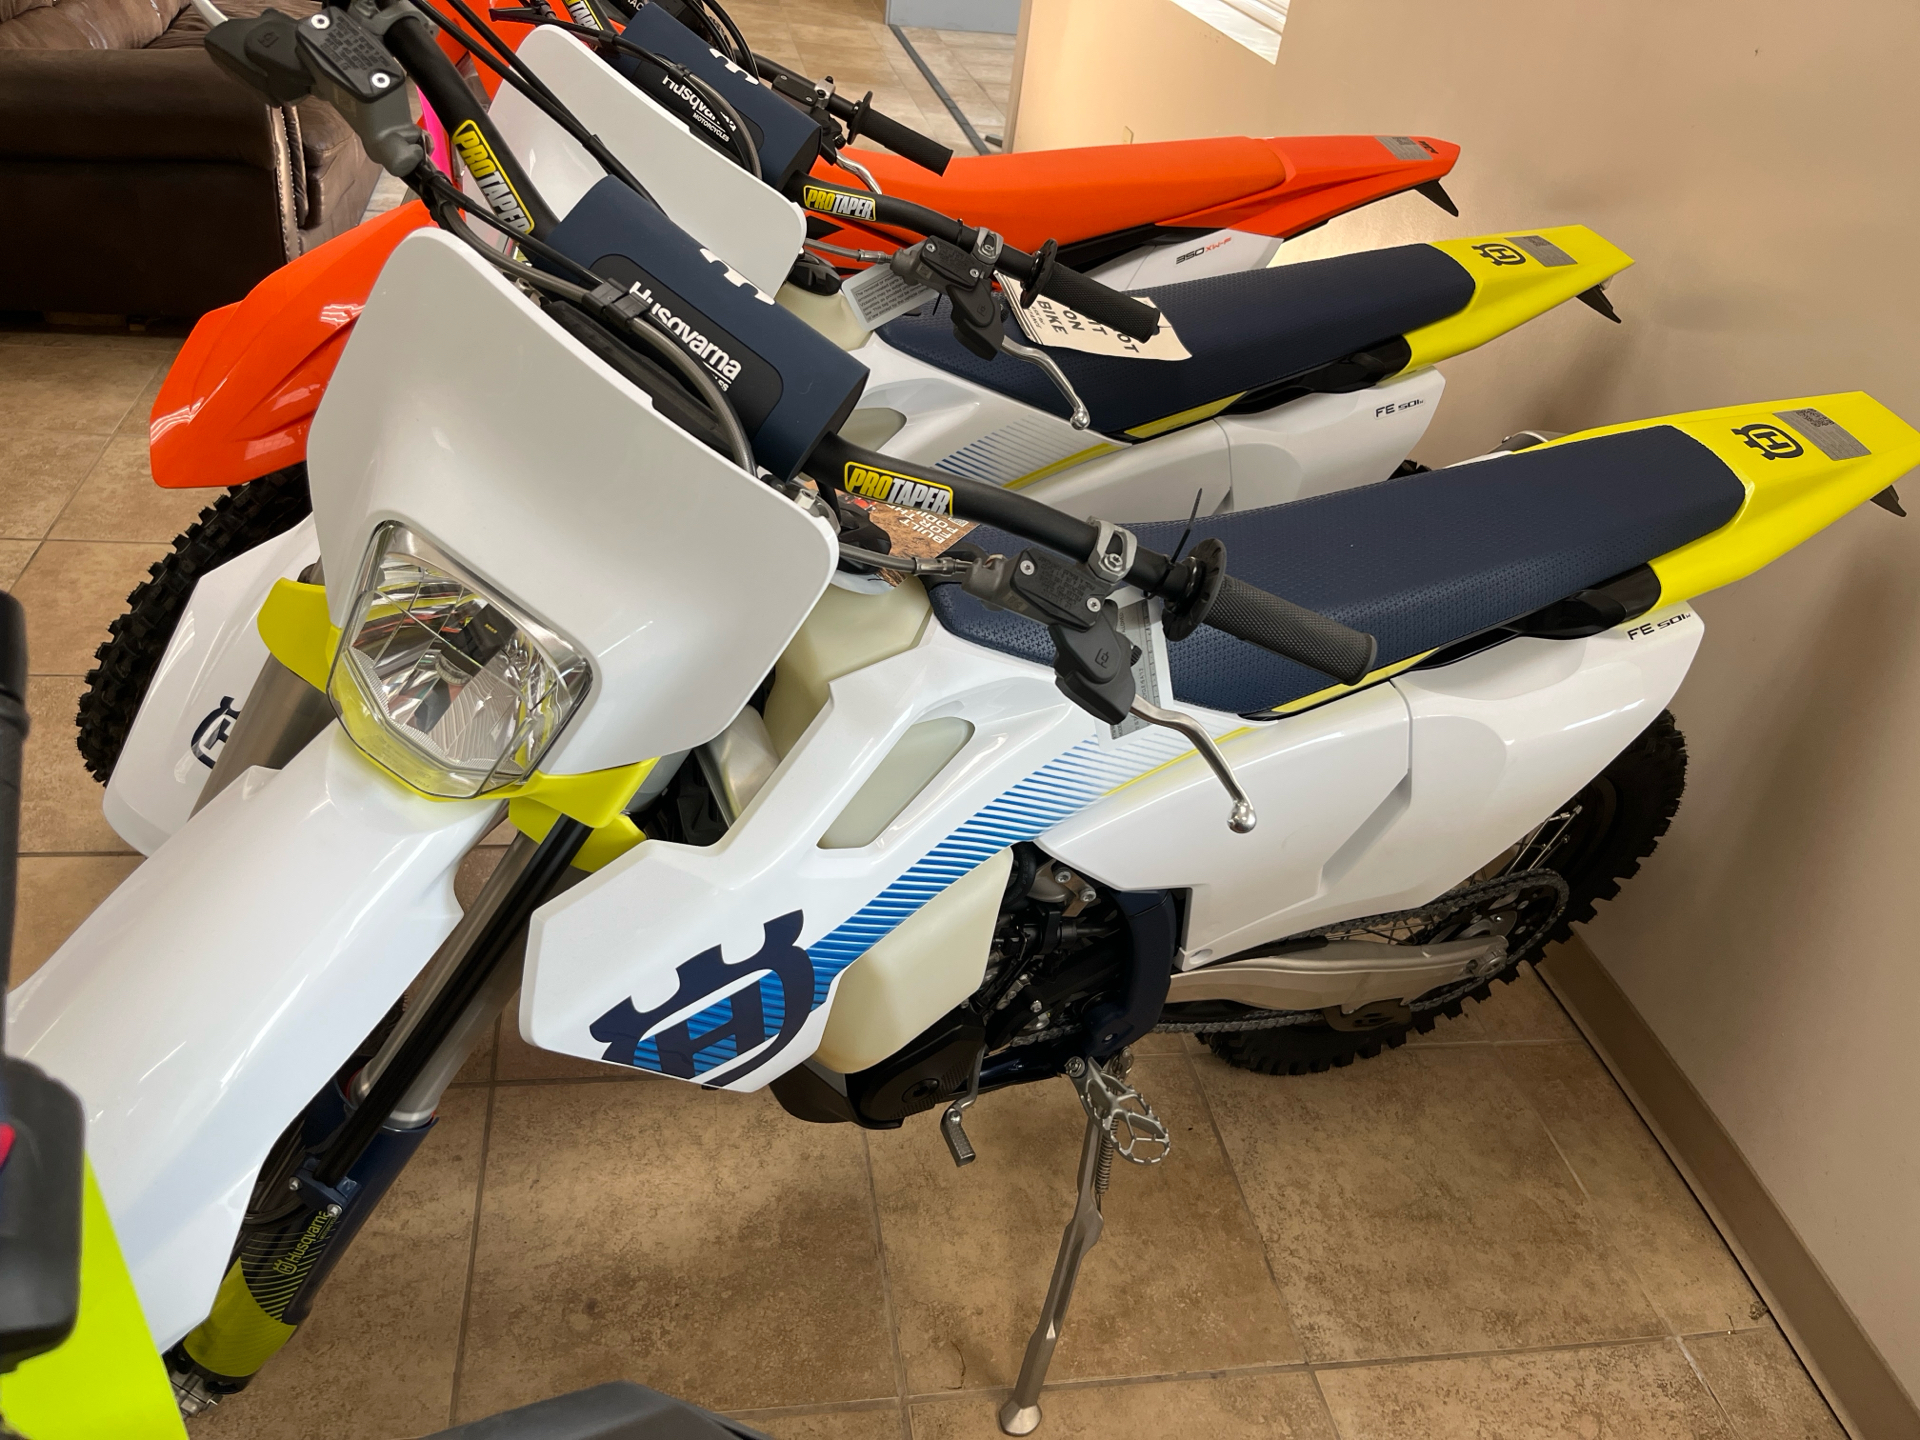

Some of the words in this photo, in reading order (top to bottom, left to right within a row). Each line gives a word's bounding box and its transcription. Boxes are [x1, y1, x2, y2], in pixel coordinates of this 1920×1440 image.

[692, 112, 730, 142] MOTORCYCLES
[806, 189, 873, 219] PROTAPER
[1176, 247, 1204, 264] 350
[1037, 300, 1068, 334] BIKE
[1063, 310, 1085, 332] ON
[1087, 321, 1108, 335] IT
[1117, 334, 1139, 353] OT
[1376, 403, 1395, 417] FE
[848, 467, 950, 515] PROTAPER
[899, 519, 946, 544] BUILT
[909, 509, 958, 534] PODI
[919, 518, 953, 539] FOR
[1627, 623, 1655, 640] FE
